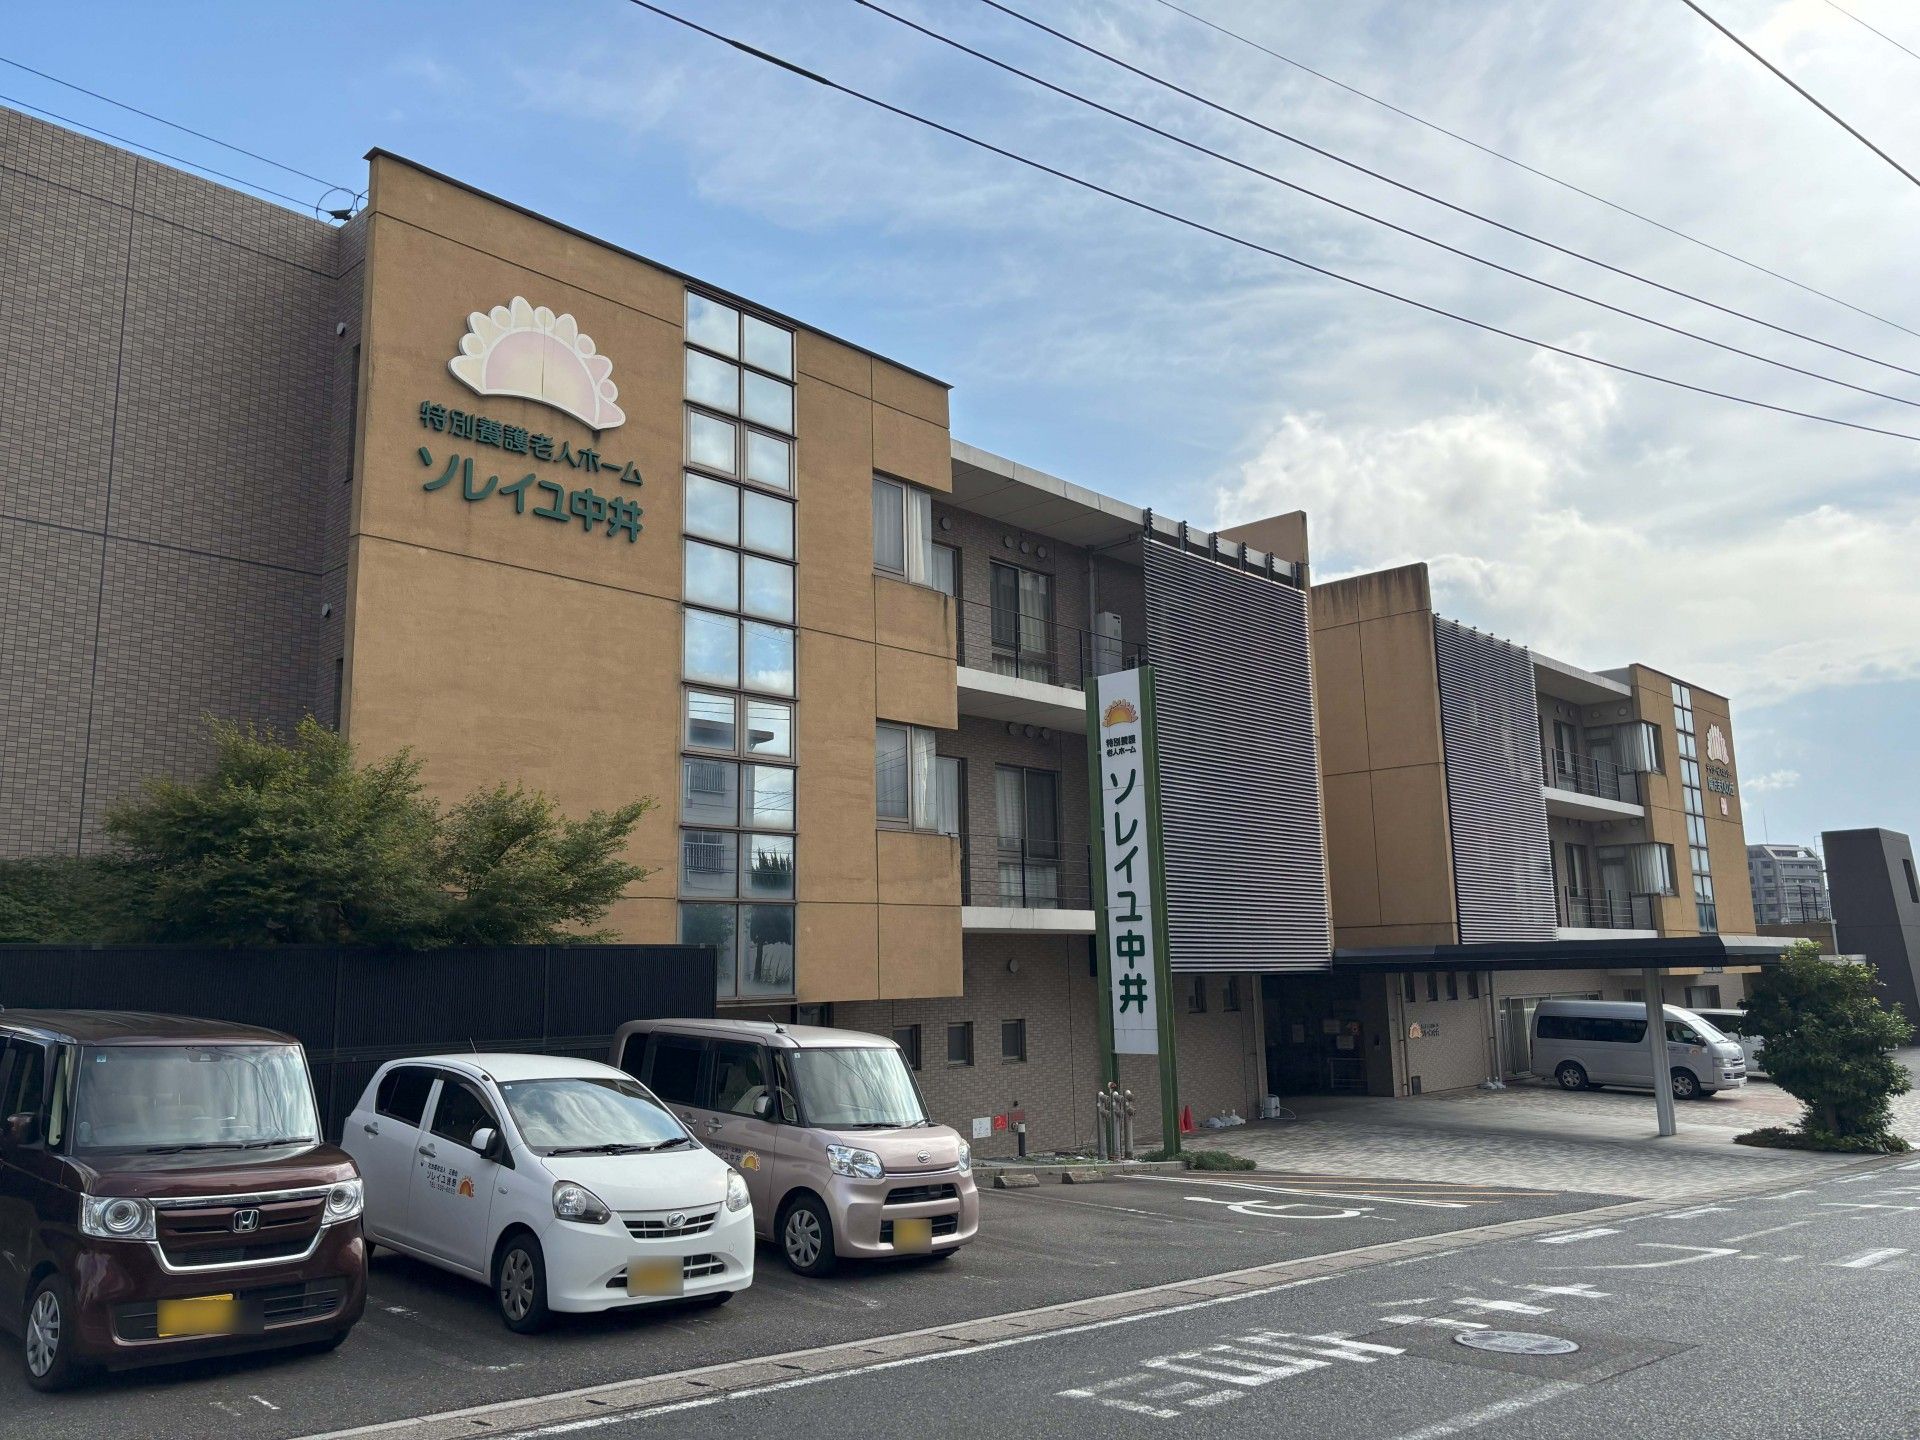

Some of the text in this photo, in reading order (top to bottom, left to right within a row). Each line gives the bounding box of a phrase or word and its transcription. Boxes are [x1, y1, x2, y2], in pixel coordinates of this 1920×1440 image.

[420, 400, 644, 487] 特別養護老人ホーム
[418, 446, 644, 543] ソレイユ中井
[1105, 734, 1136, 748] 特別養護
[1106, 746, 1137, 758] 老人ホーム
[1110, 768, 1148, 1014] ソレイユ中井
